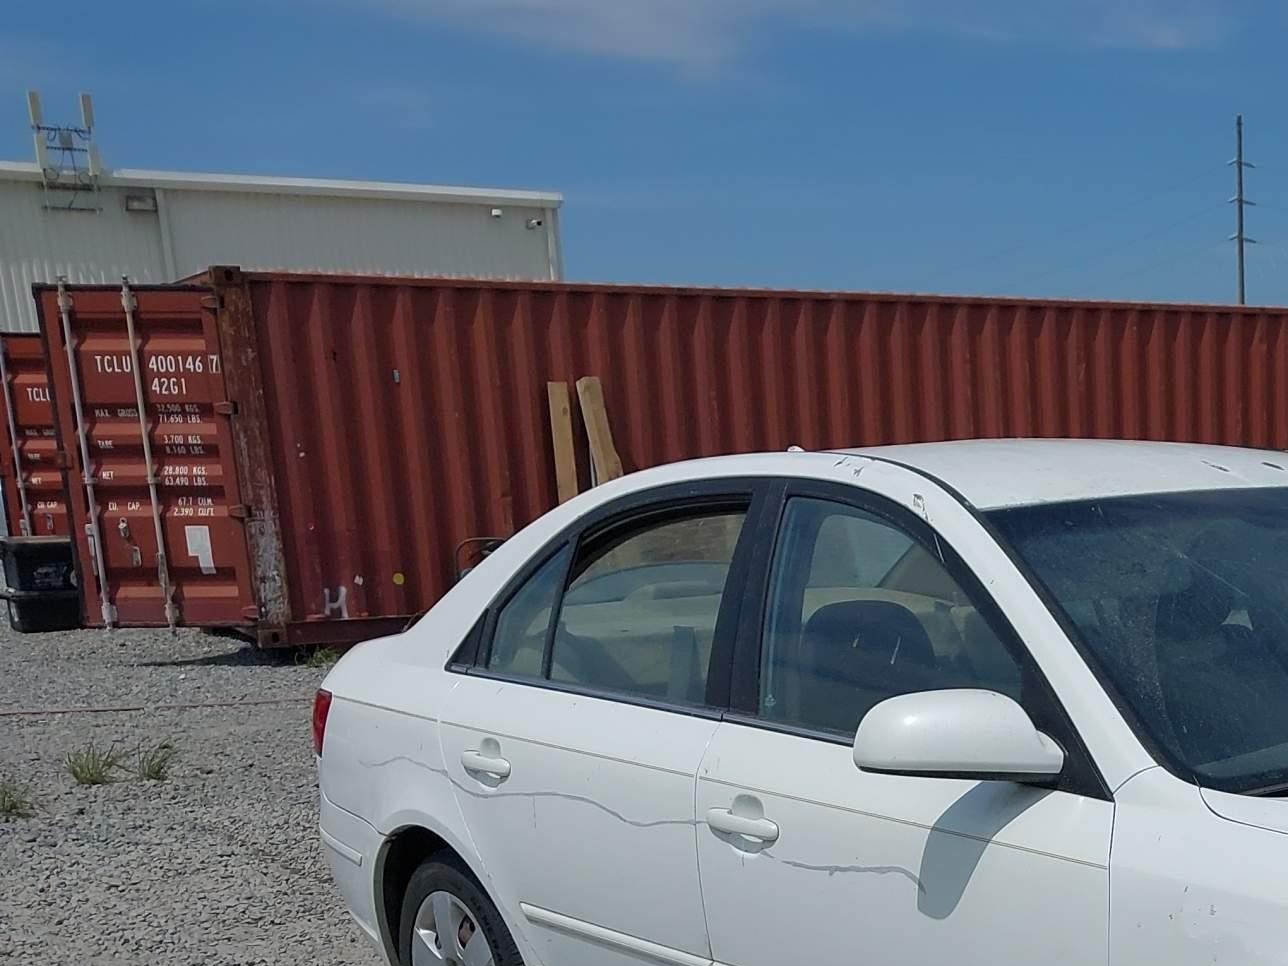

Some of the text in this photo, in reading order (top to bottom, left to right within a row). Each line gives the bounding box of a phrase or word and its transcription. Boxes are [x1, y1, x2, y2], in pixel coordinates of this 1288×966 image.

[94, 355, 131, 373] TCLU
[148, 355, 203, 373] 400146
[151, 378, 186, 395] 42G1
[163, 435, 184, 444] 3.700
[102, 471, 114, 480] NET
[173, 507, 194, 516] 2.390
